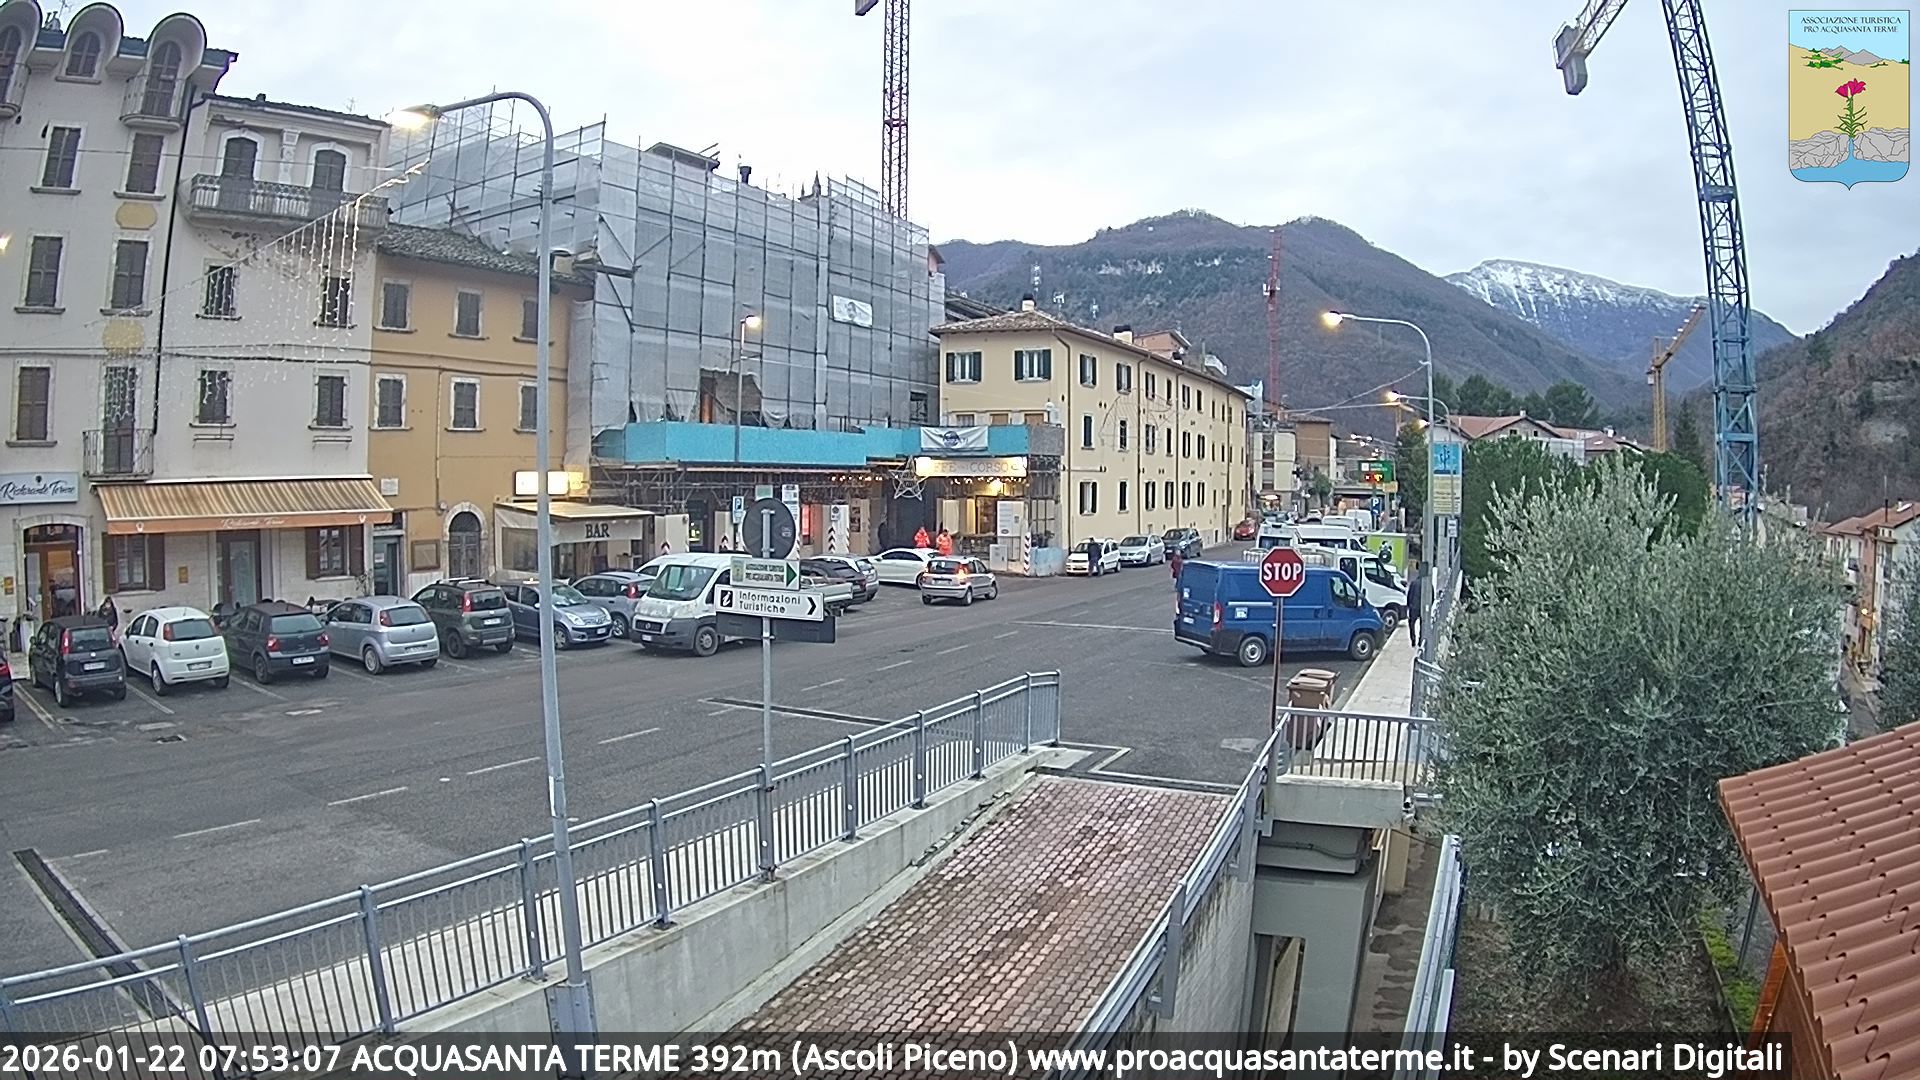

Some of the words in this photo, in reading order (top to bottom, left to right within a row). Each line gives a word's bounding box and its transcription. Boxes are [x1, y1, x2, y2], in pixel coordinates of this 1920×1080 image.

[969, 461, 1009, 473] CORSO
[585, 522, 610, 538] BAR
[1263, 562, 1302, 581] STOP
[739, 590, 801, 605] Informazioni
[739, 601, 786, 614] Turistiche
